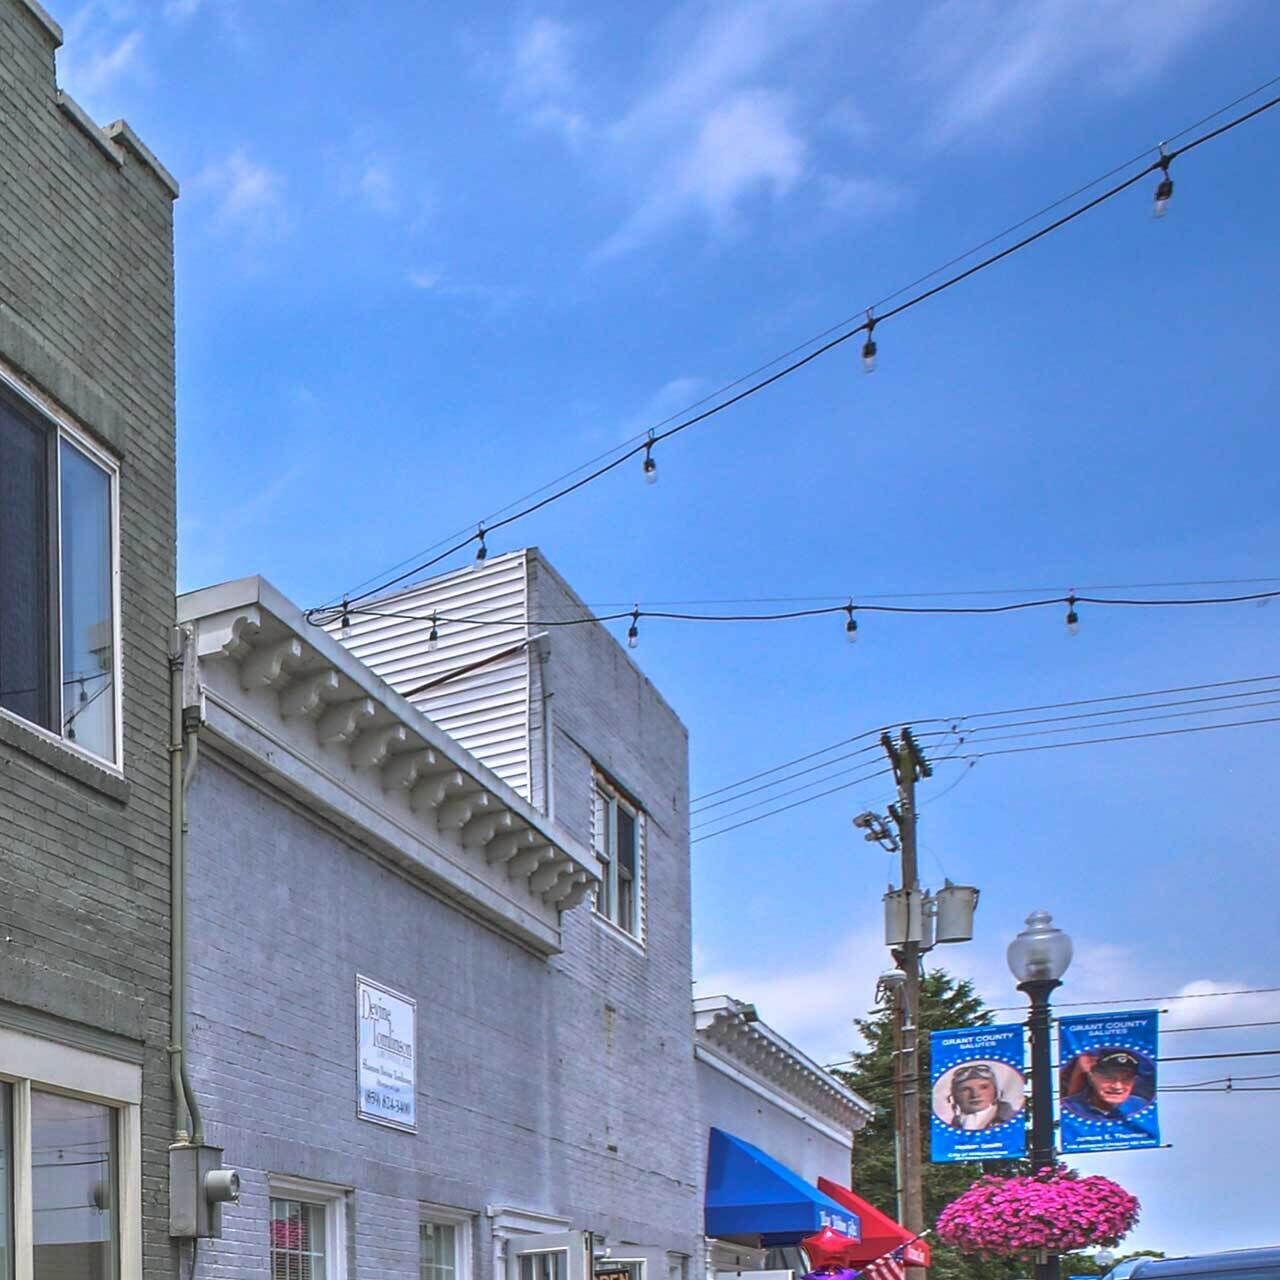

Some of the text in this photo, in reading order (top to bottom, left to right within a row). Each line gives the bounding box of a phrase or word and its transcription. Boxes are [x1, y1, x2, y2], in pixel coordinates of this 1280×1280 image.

[1069, 1019, 1148, 1032] GRANT COUNTY
[1088, 1028, 1129, 1037] SALUTES
[942, 1032, 1014, 1046] GRANT COUNTY
[959, 1041, 997, 1050] SALUTES
